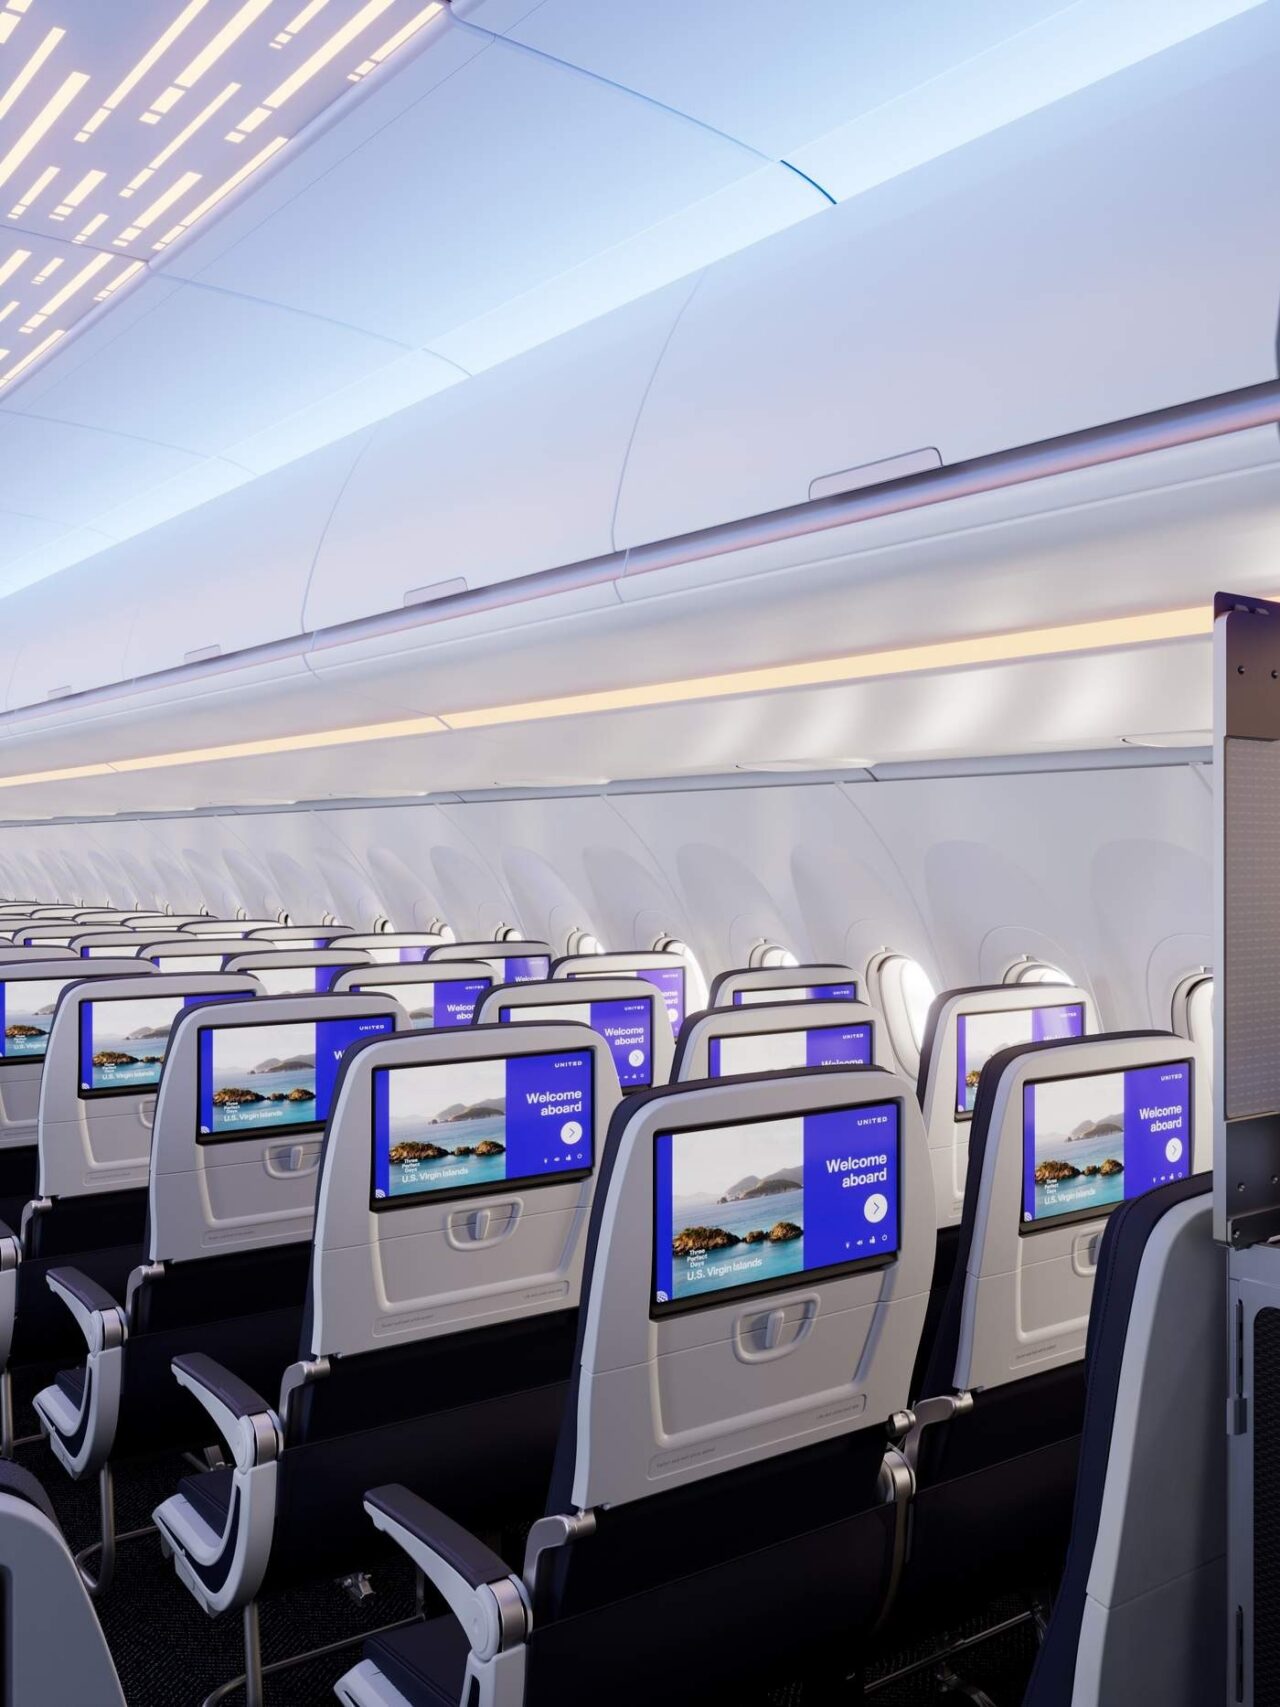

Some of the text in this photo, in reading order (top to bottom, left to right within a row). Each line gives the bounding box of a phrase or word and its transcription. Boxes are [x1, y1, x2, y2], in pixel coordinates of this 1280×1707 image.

[447, 1004, 475, 1013] Welco
[604, 1027, 644, 1037] Welcome
[614, 1035, 644, 1046] aboard
[554, 1060, 583, 1069] UNITED
[1160, 1073, 1183, 1081] UNITED
[526, 1088, 582, 1104] Welcome
[540, 1102, 582, 1117] aboard
[1139, 1104, 1182, 1120] Welcome
[857, 1116, 888, 1126] UNITED
[1150, 1117, 1182, 1133] aboard
[826, 1153, 888, 1174] Welcome
[402, 1174, 418, 1183] U.S.
[419, 1171, 442, 1181] Virgin
[842, 1168, 888, 1189] aboard
[687, 1257, 763, 1281] U.S. Virgin Islands
